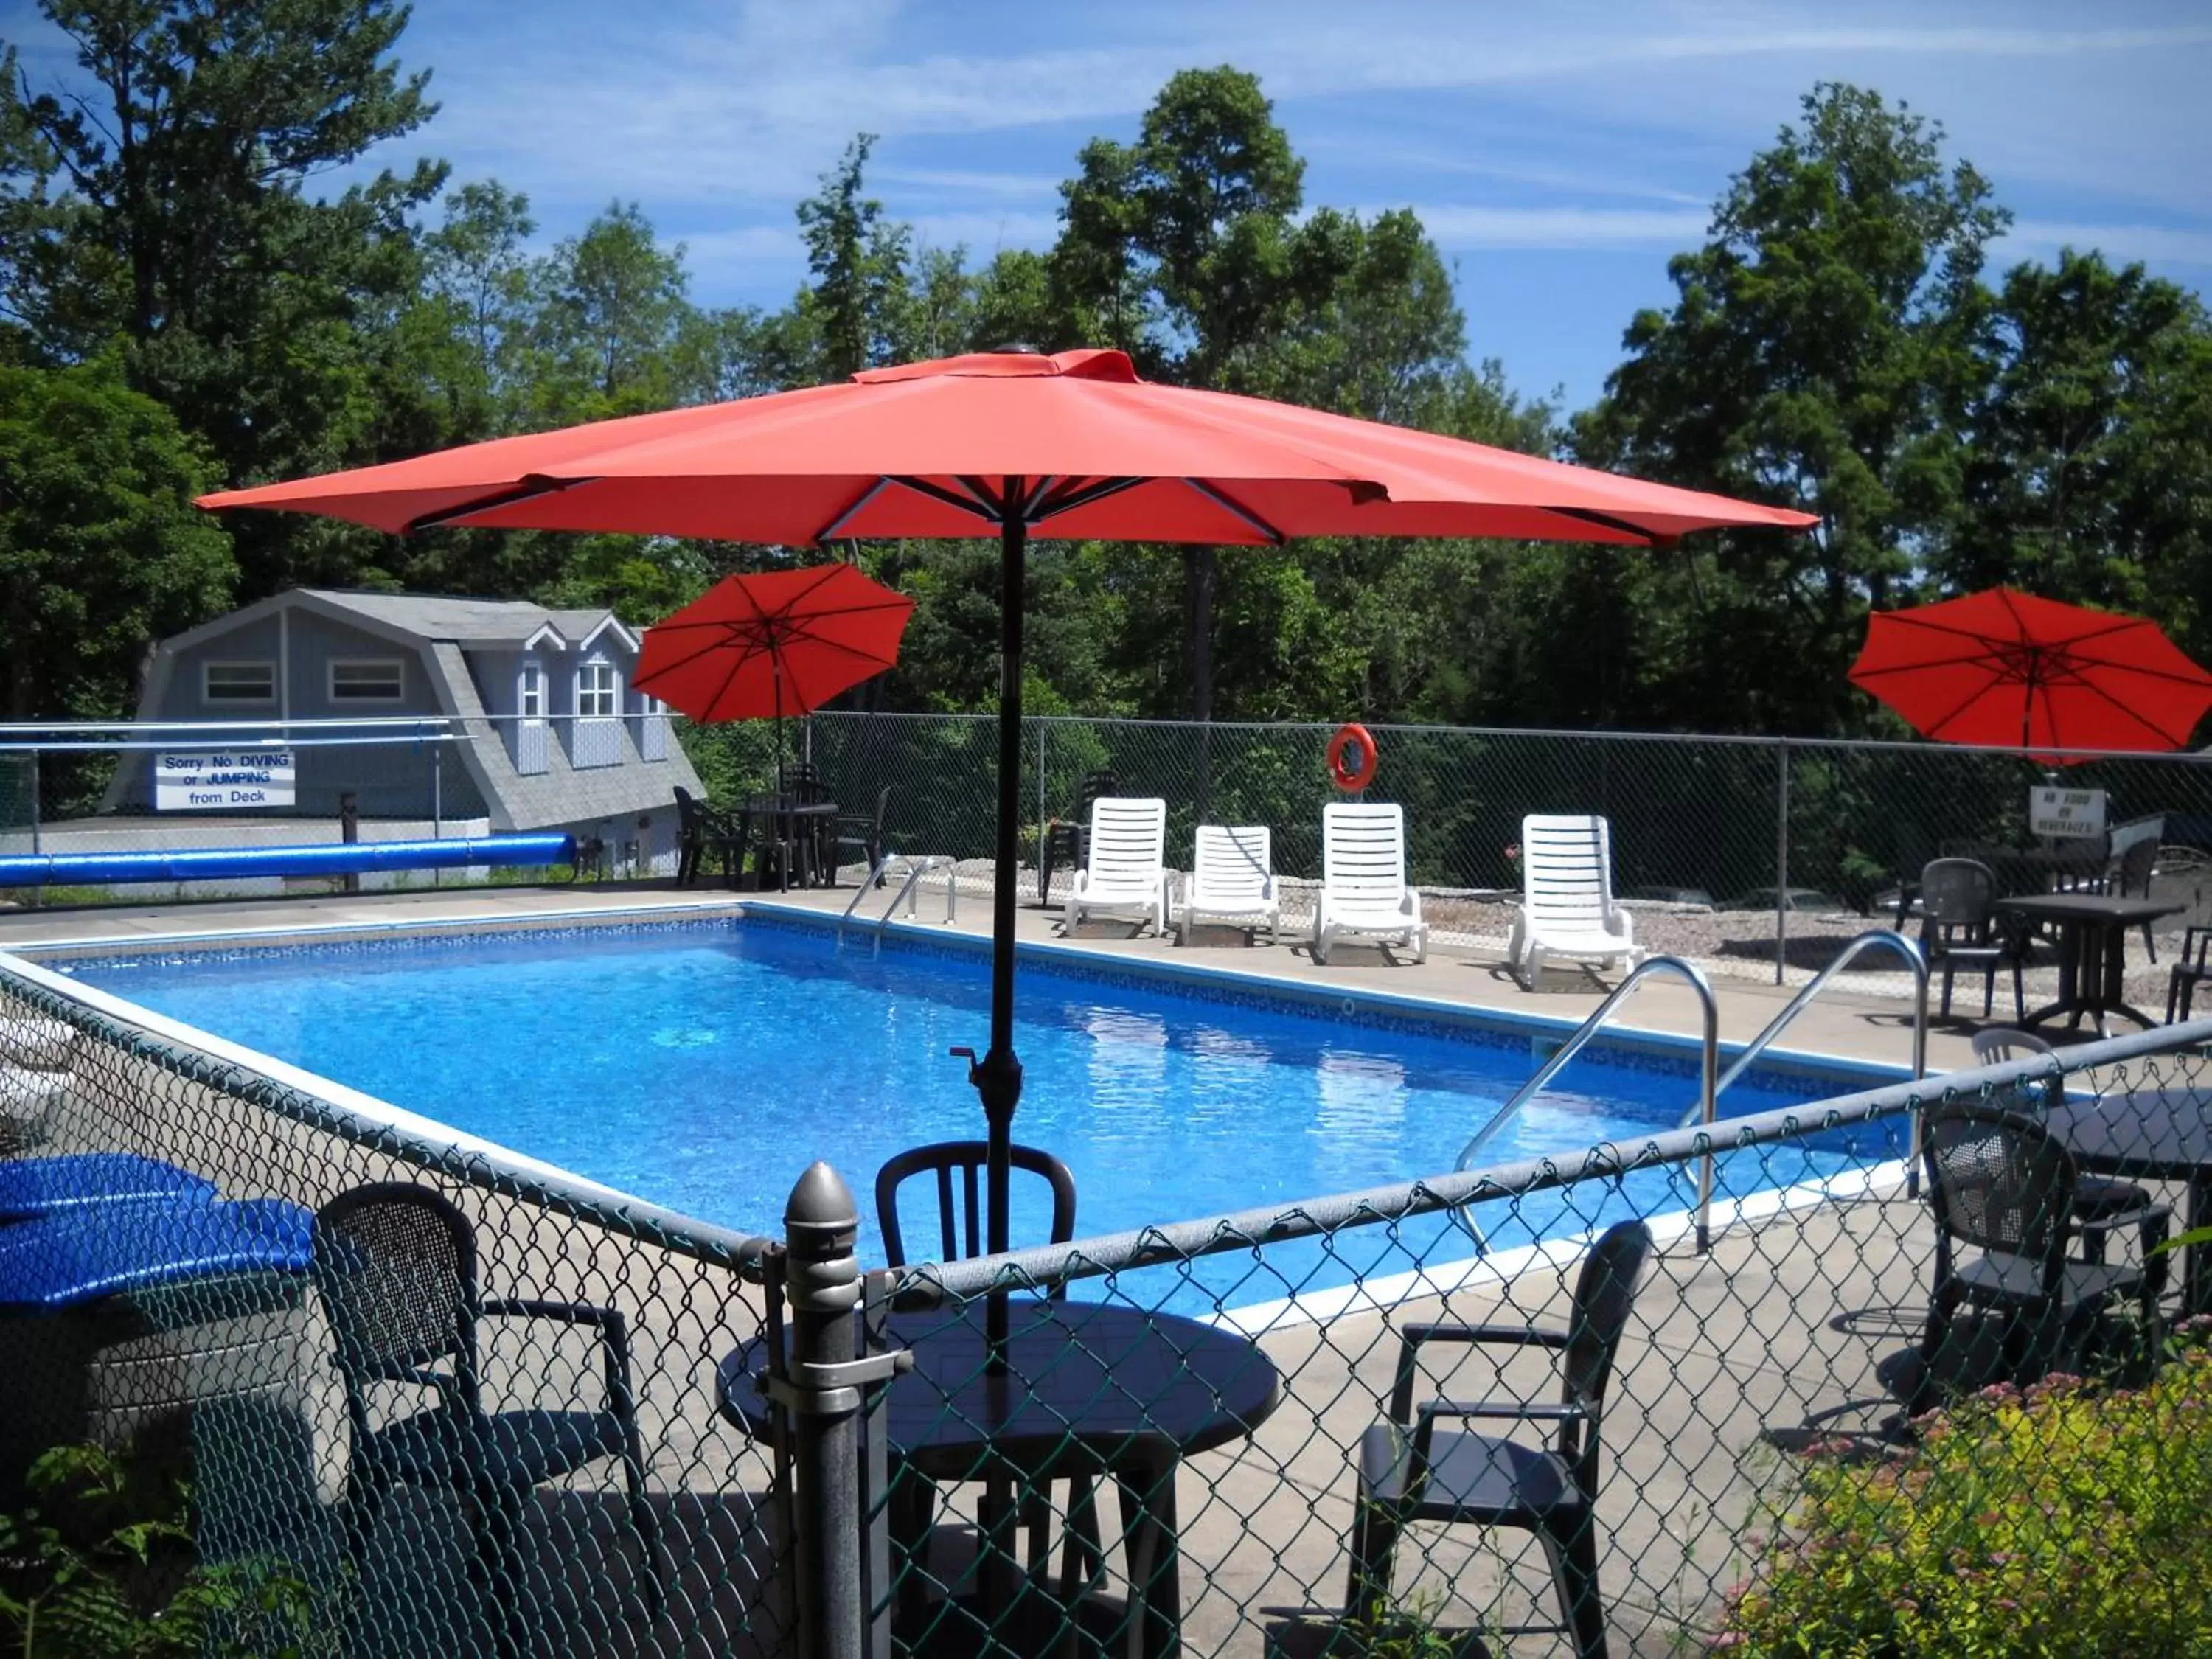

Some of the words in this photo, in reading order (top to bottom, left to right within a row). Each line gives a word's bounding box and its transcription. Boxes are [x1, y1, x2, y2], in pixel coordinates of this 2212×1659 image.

[164, 757, 204, 771] Sorry
[213, 755, 232, 768] No
[240, 754, 288, 767] DIVING
[184, 775, 198, 785] or
[206, 771, 271, 785] JUMPING
[189, 791, 223, 804] from
[231, 790, 265, 802] Deck
